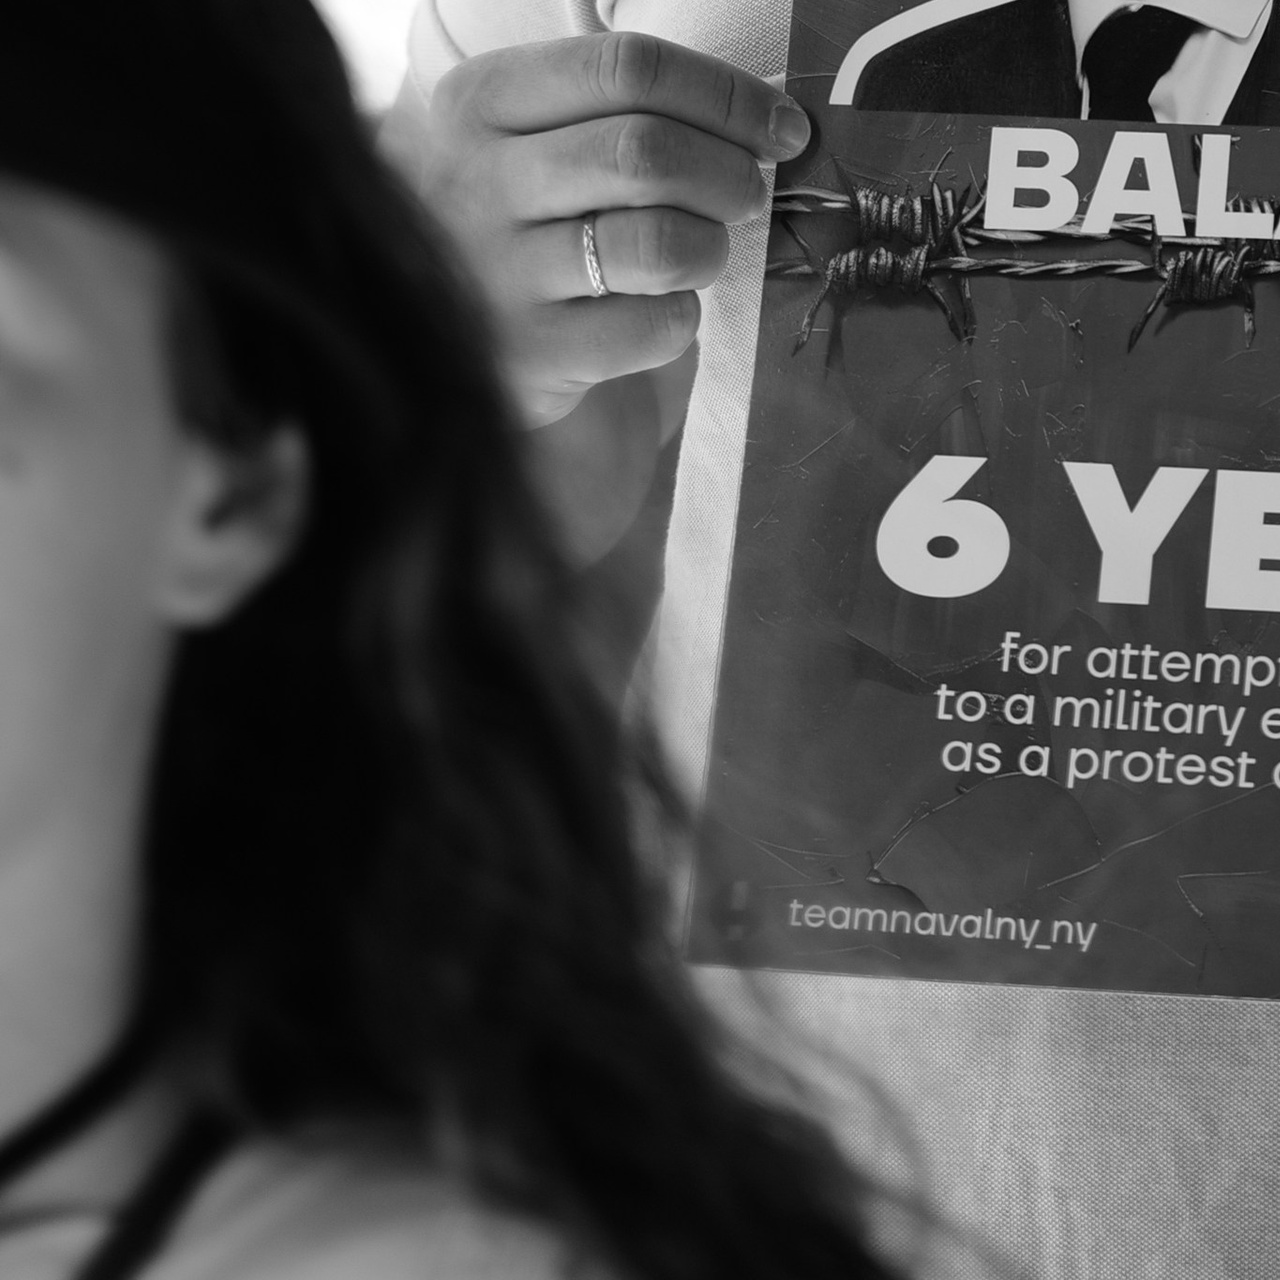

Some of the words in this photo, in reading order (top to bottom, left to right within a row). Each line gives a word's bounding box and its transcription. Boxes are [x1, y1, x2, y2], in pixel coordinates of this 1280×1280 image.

[875, 454, 1011, 598] 6
[1000, 631, 1072, 675] for
[933, 683, 987, 722] to
[1003, 693, 1035, 725] a
[1053, 687, 1246, 747] military
[941, 740, 1002, 774] as
[1019, 745, 1050, 777] a
[1066, 746, 1257, 789] protest
[788, 897, 1099, 953] teamnavalny_ny
